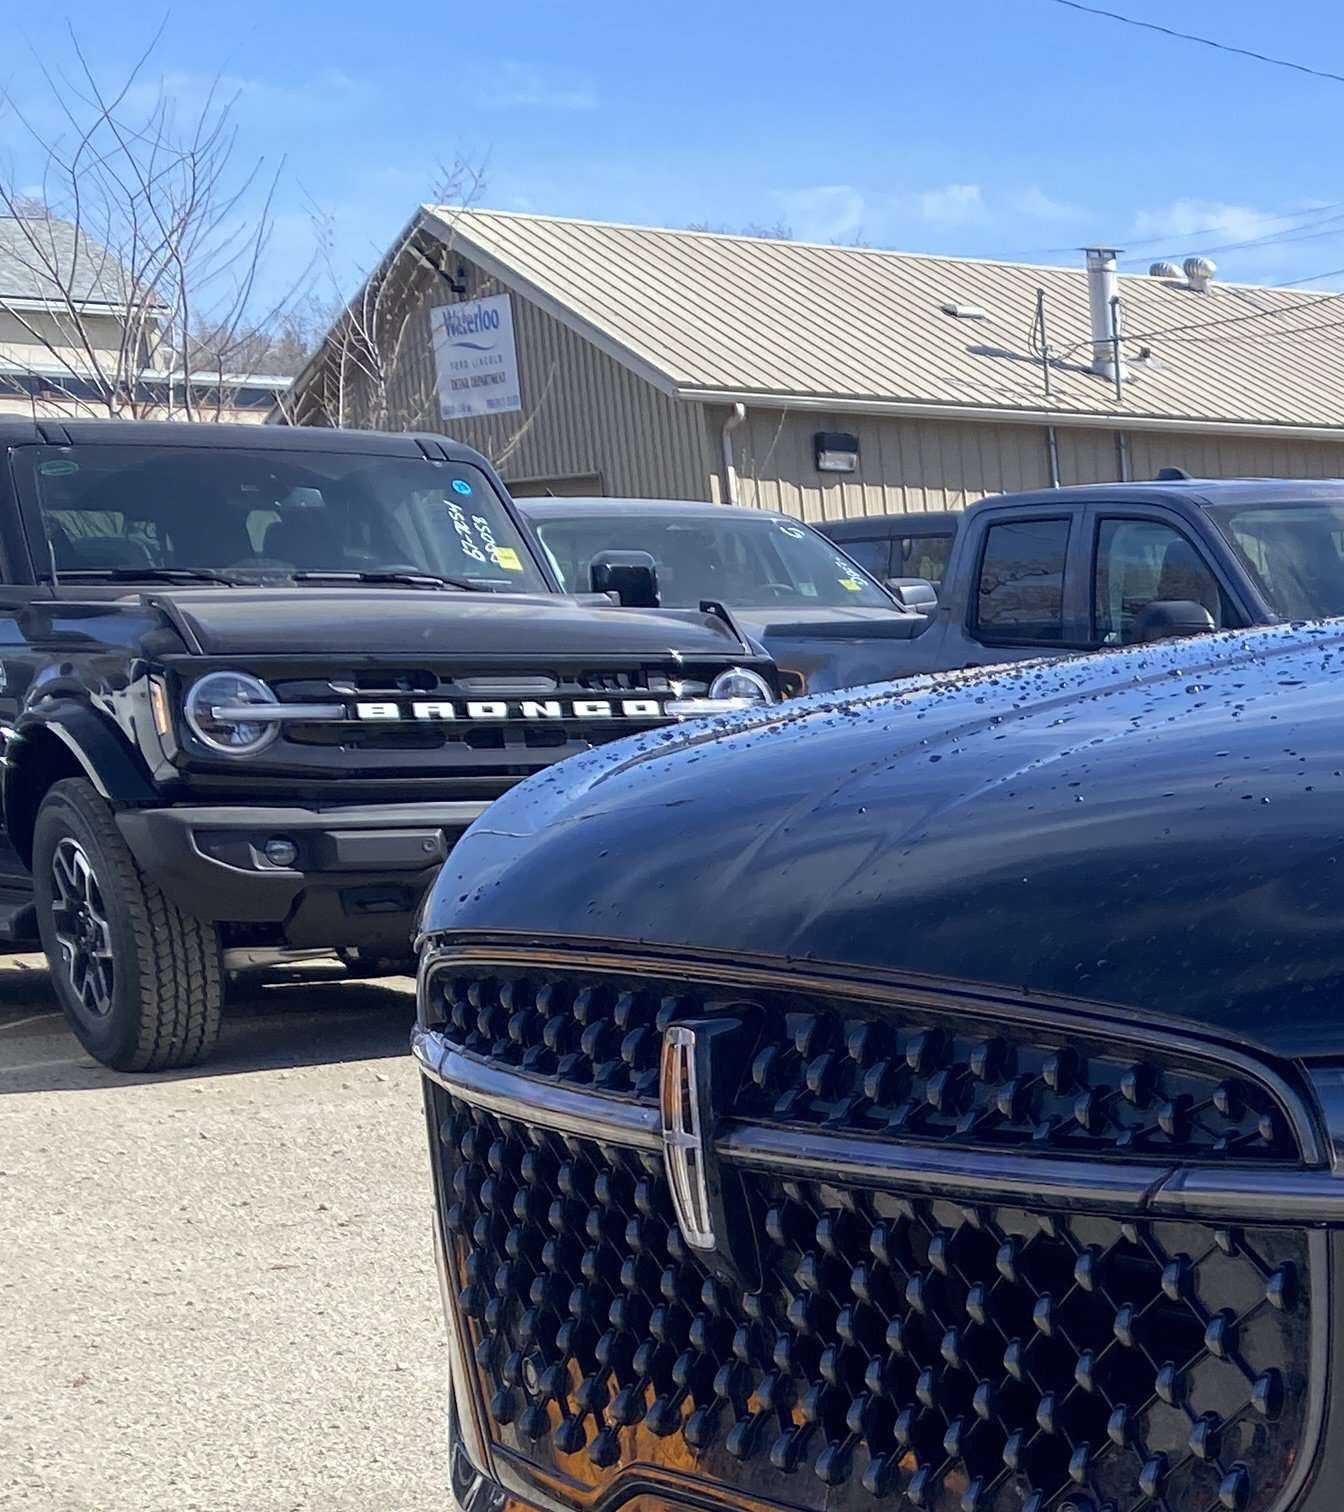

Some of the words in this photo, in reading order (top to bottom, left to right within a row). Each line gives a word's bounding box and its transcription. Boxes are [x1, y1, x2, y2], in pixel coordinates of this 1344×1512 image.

[442, 304, 499, 336] Waterloo
[472, 354, 503, 369] LINCOLN
[470, 371, 506, 388] DEPARTMENT
[356, 701, 661, 720] BRONCO
